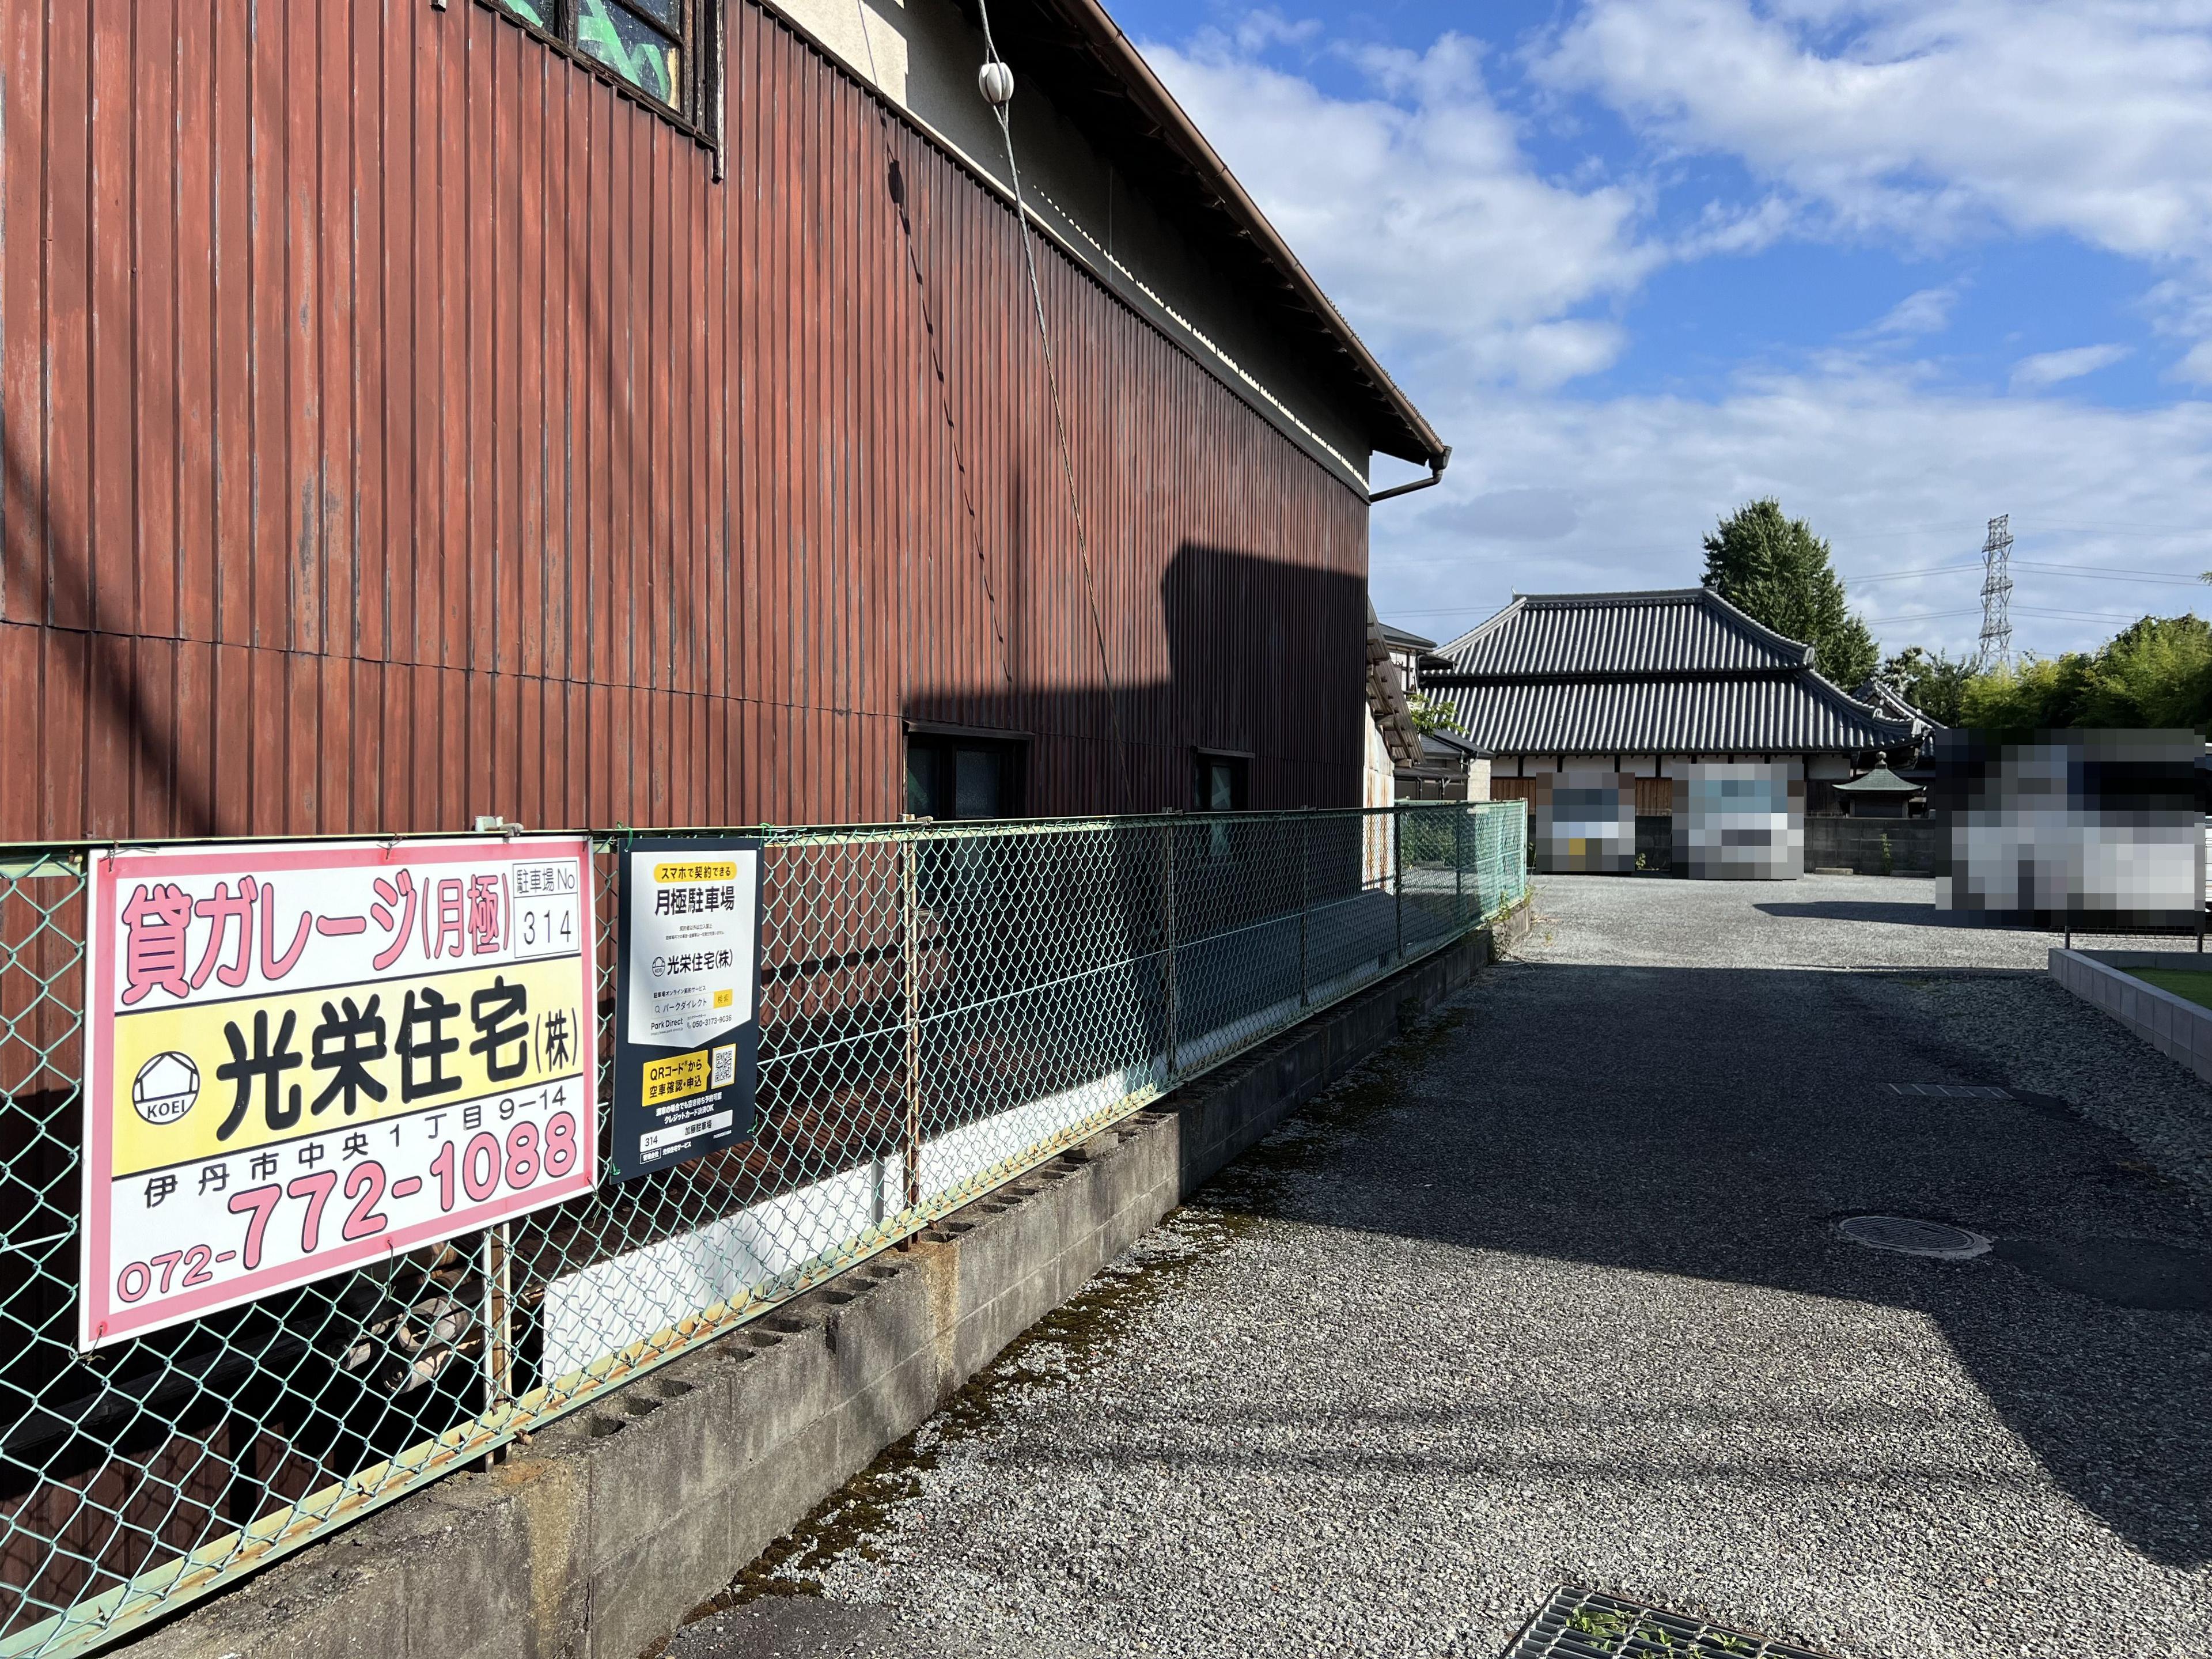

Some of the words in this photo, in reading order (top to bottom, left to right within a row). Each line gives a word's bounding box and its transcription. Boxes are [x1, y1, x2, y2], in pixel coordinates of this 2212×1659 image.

[517, 868, 575, 893] 駐車場No
[661, 866, 731, 880] スマホで契約できる
[654, 885, 736, 916] 月極駐車場
[122, 869, 510, 1006] 貸ガレージ(月極)
[524, 910, 571, 945] 314
[667, 949, 733, 975] 光栄住宅(株)
[663, 998, 707, 1013] パークダイレクト
[718, 994, 729, 1003] 検索
[651, 1021, 664, 1030] Park
[666, 1018, 683, 1028] Direct
[216, 975, 577, 1142] 光栄住宅(株)
[147, 1099, 186, 1120] KOEI
[645, 1135, 658, 1146] 314
[117, 1111, 577, 1303] 072-772-1088
